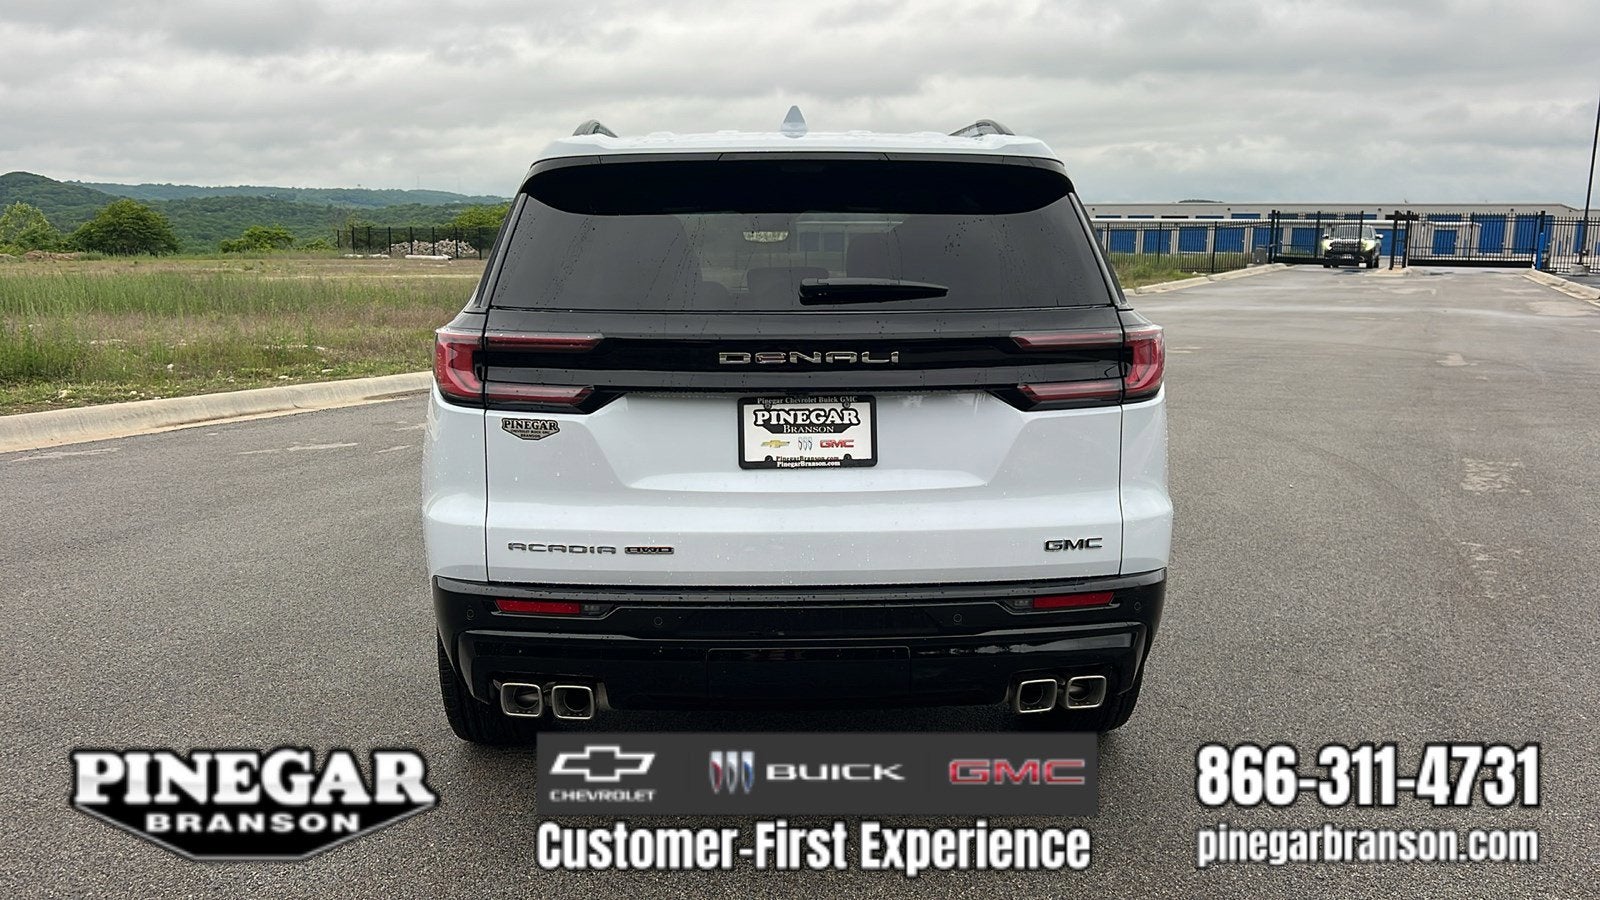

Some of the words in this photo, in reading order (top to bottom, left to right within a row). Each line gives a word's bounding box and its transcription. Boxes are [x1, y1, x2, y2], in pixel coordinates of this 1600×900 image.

[719, 352, 899, 364] DENALI
[757, 397, 783, 405] Pinegar
[785, 396, 817, 404] Chevrolet
[754, 409, 860, 425] PINEGAR
[504, 420, 557, 431] PINEGAR
[783, 424, 834, 433] BRANSON
[820, 439, 854, 448] GMC
[508, 542, 617, 554] ACADIA
[625, 546, 674, 554] AWD
[1044, 538, 1102, 552] GMC
